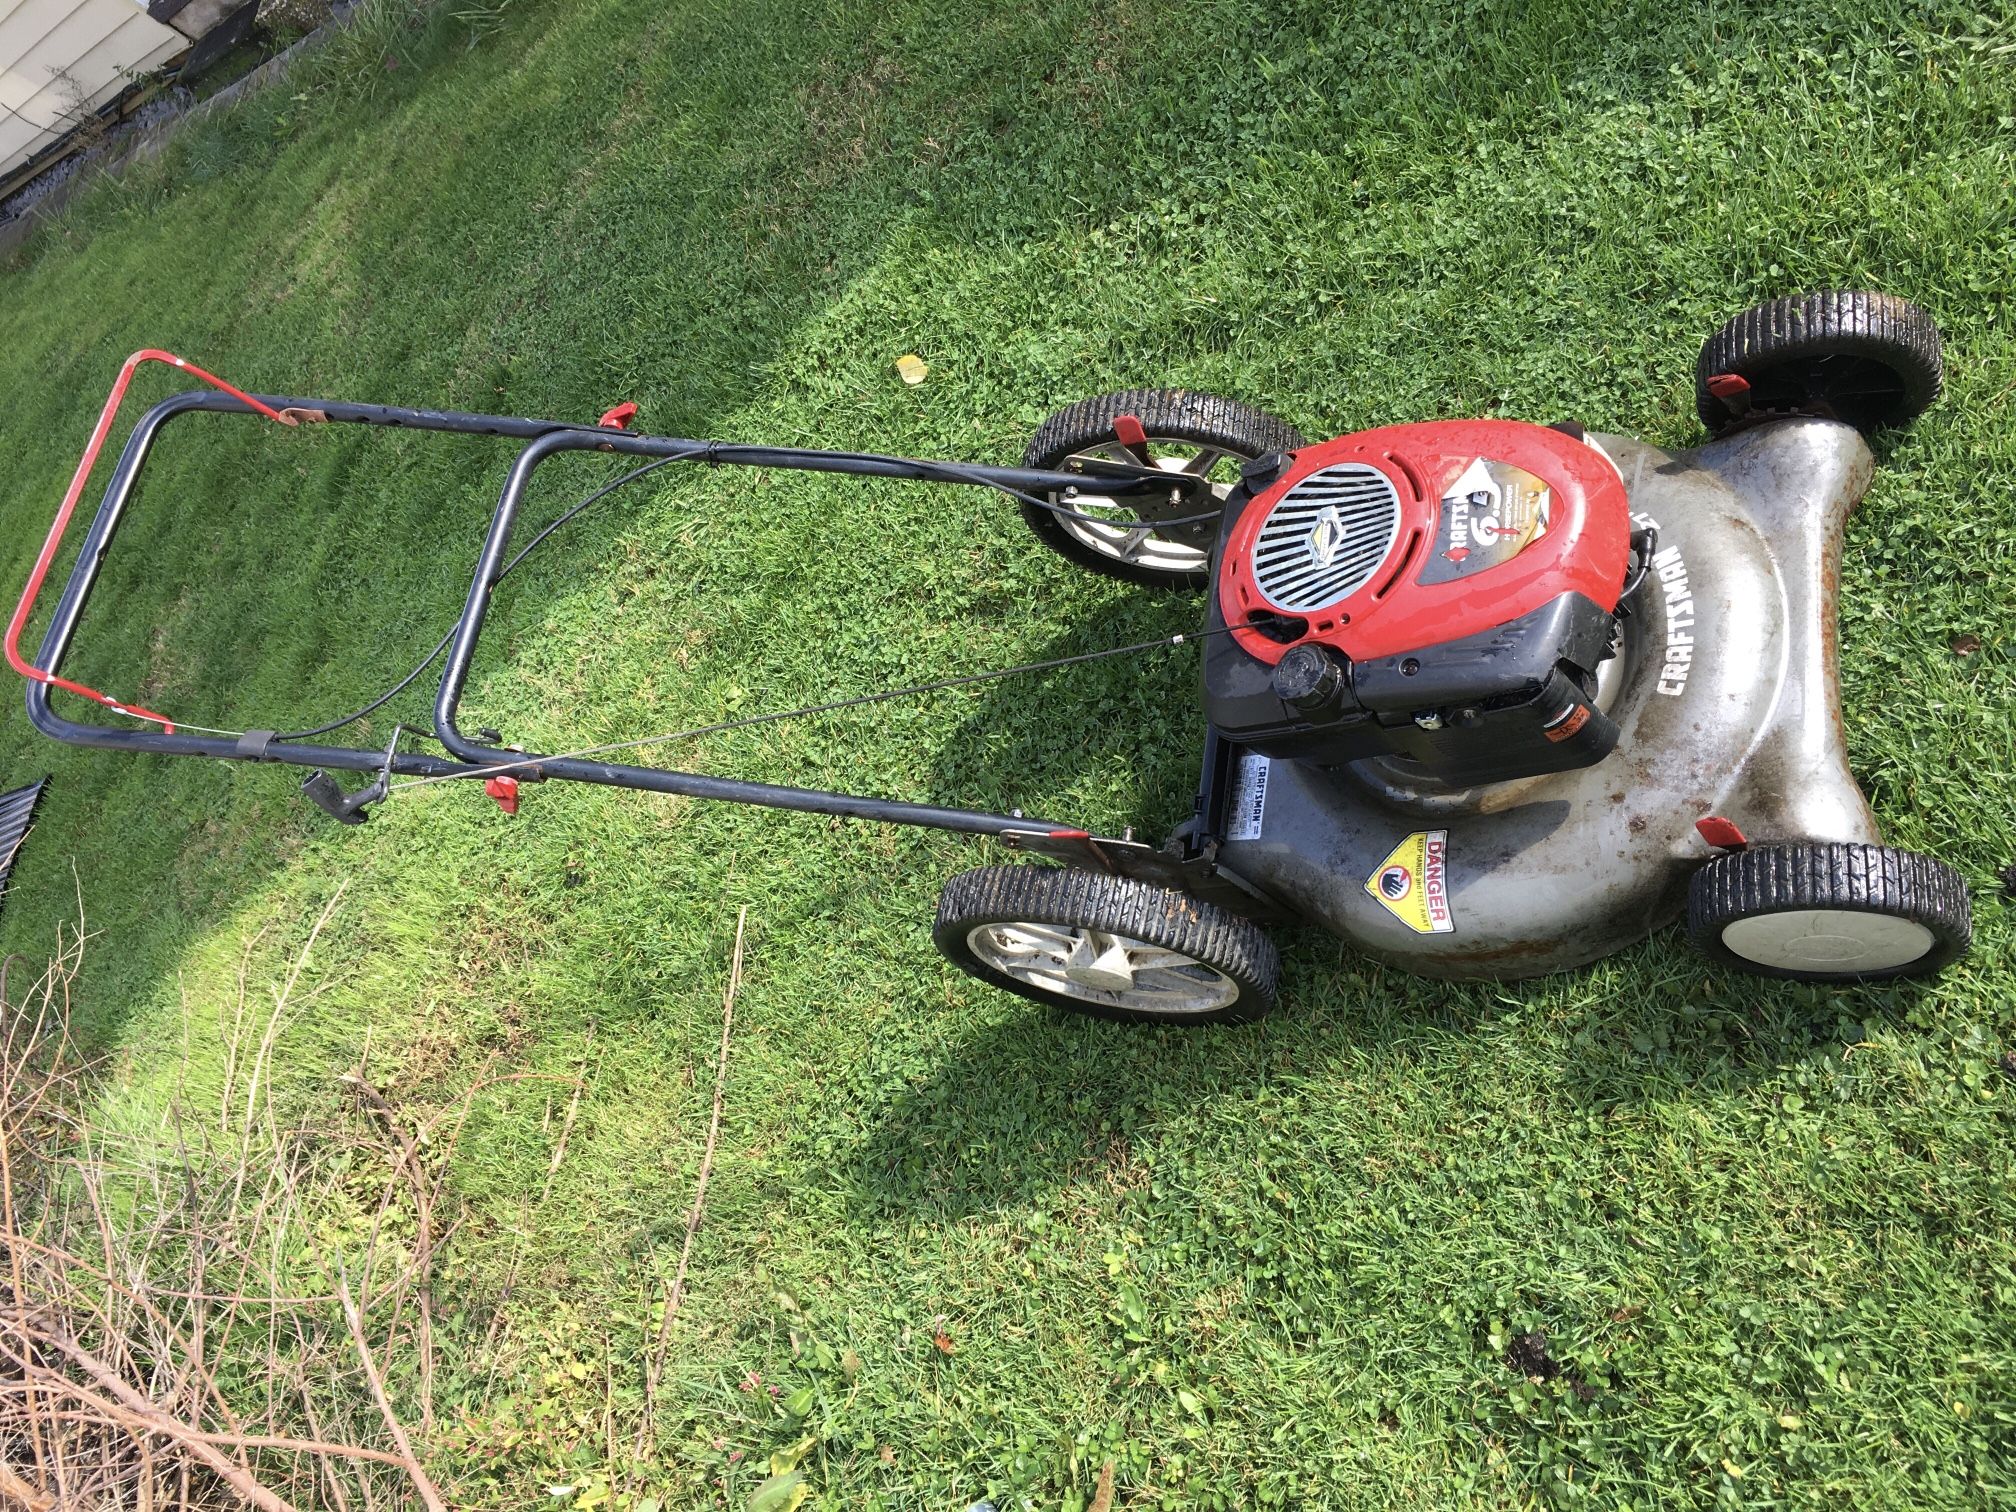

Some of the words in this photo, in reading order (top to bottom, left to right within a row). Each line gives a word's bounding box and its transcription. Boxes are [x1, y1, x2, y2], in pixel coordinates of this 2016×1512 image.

[1504, 485, 1513, 541] HRSEPOWER
[1652, 545, 1694, 696] CRAFTSMAN
[1252, 766, 1267, 822] CRAFTSMAN
[1415, 854, 1423, 876] HANDS
[1427, 841, 1447, 921] DANGER
[1417, 891, 1425, 907] FEET
[1419, 908, 1430, 927] AWAY
